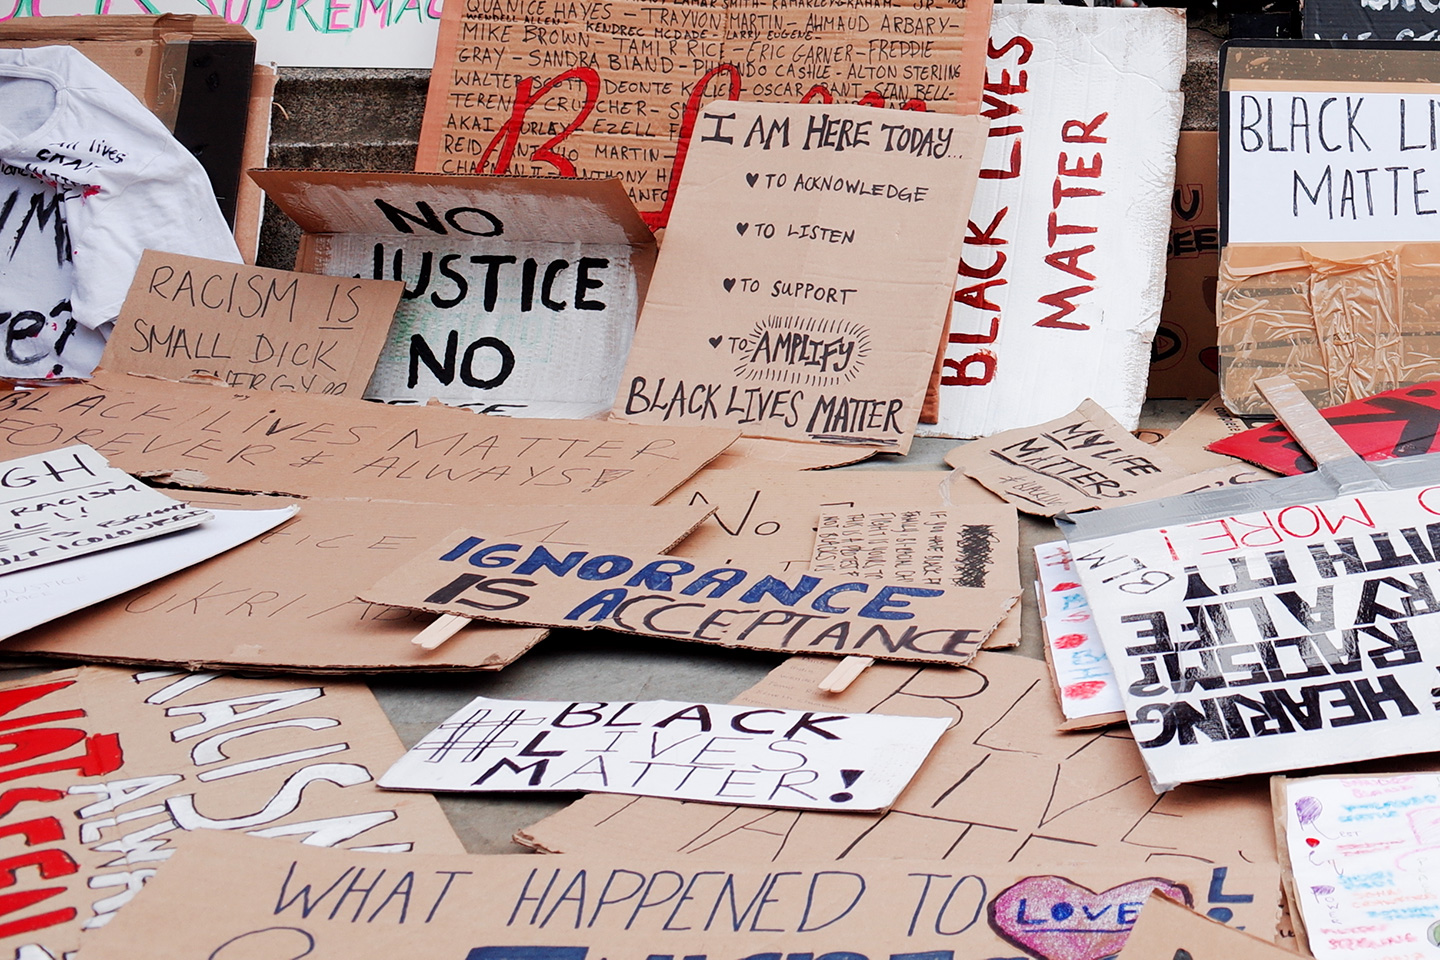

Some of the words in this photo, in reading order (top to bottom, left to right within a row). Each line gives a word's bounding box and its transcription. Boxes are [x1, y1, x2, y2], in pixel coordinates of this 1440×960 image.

[462, 23, 513, 43] MIKE
[523, 24, 589, 47] BROWN
[554, 3, 612, 21] HAYES
[702, 113, 735, 144] I
[745, 114, 789, 149] AM
[803, 114, 872, 150] HERE
[766, 173, 787, 188] TO
[794, 173, 928, 203] ACKNOWLEDGE
[754, 223, 776, 238] TO
[787, 223, 856, 244] LISTEN
[149, 263, 299, 323] RACISM
[325, 281, 362, 323] IS
[740, 278, 761, 293] TO
[771, 280, 857, 305] SUPPORT
[130, 318, 232, 360] SMALL
[250, 332, 339, 373] DICK
[729, 337, 749, 351] TO
[750, 331, 856, 373] AMPLIFY
[625, 376, 720, 420] BLACK
[725, 386, 805, 429] LIVES
[806, 398, 904, 435] MATTER
[1099, 441, 1165, 482] LIFE
[1165, 499, 1372, 562] MORE!
[440, 535, 945, 620] IGNORANCE
[423, 573, 538, 611] IS
[564, 589, 982, 658] ACCEPTANCE
[1137, 672, 1422, 750] HEARING
[273, 860, 473, 925] WHAT
[507, 868, 867, 934] HAPPENED
[906, 871, 987, 936] TO
